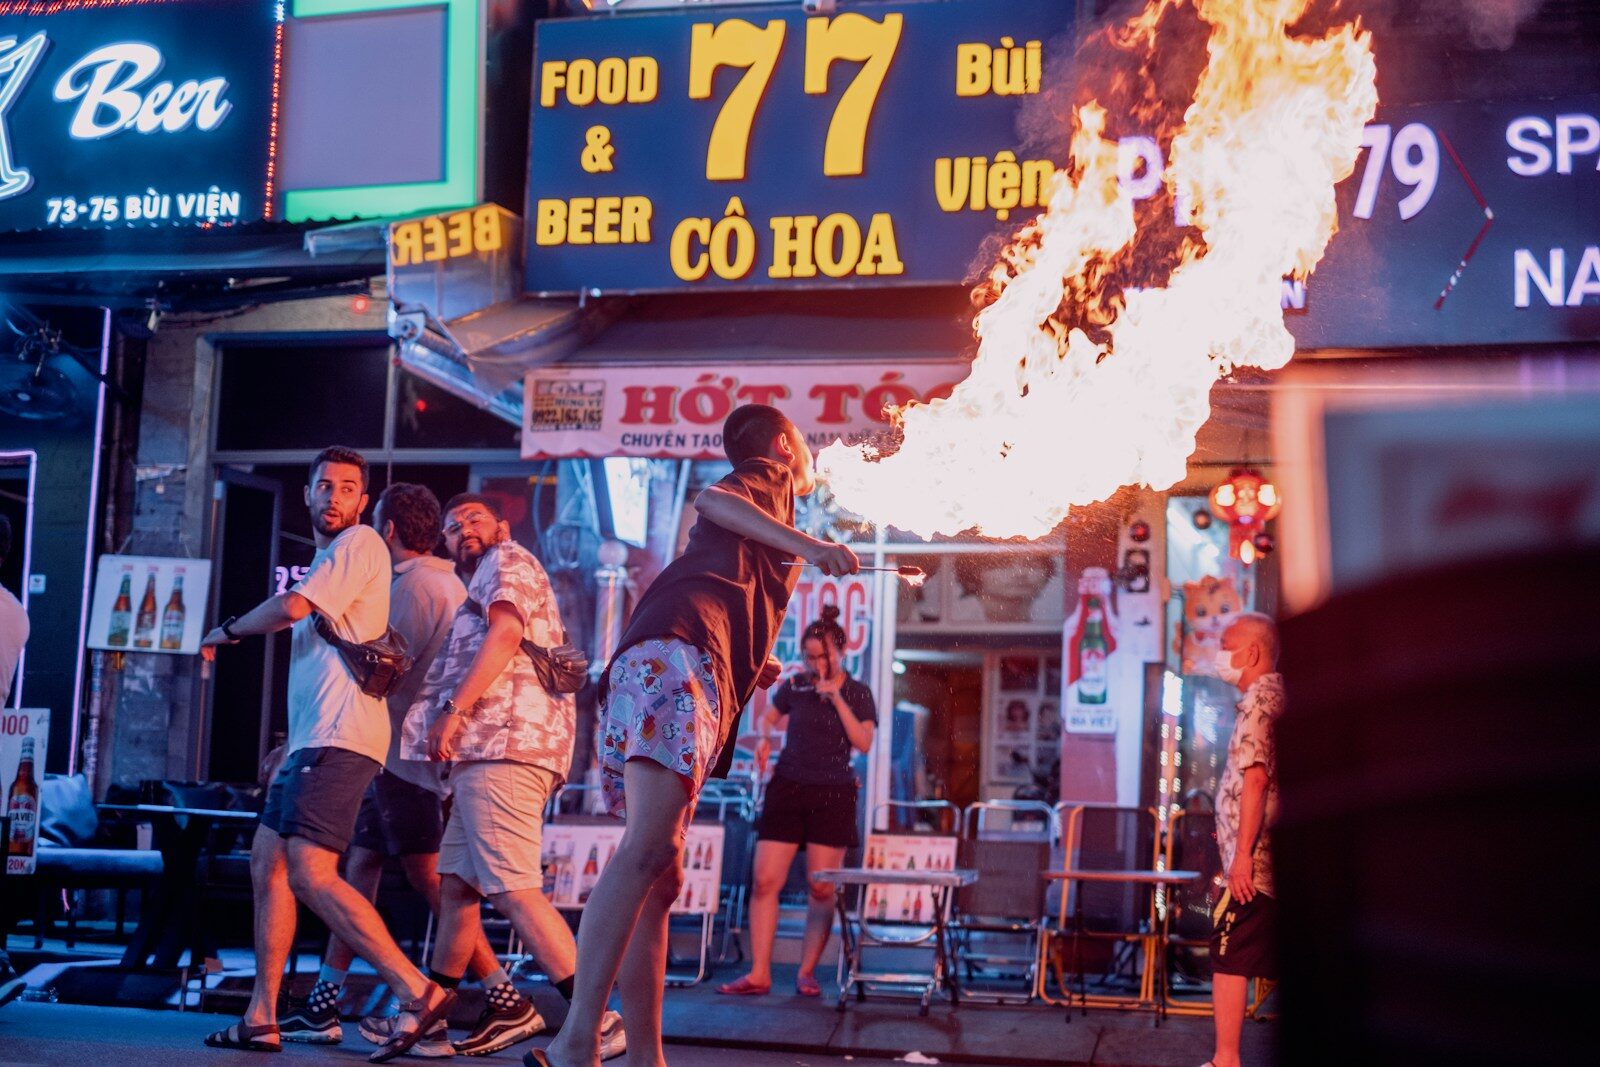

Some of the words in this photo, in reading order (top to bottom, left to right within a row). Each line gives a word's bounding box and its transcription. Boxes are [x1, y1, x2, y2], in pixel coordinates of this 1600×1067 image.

[54, 43, 232, 140] Beer
[540, 56, 658, 108] FOOD
[581, 125, 613, 173] &
[1506, 113, 1600, 176] SP
[1353, 122, 1440, 220] 79
[47, 196, 119, 224] 73-75
[125, 188, 170, 221] BÙI
[177, 186, 240, 222] VIỆN
[535, 196, 652, 246] BEER
[670, 197, 755, 281] CÔ
[768, 213, 903, 278] HOA
[620, 430, 687, 447] CHUYÊN
